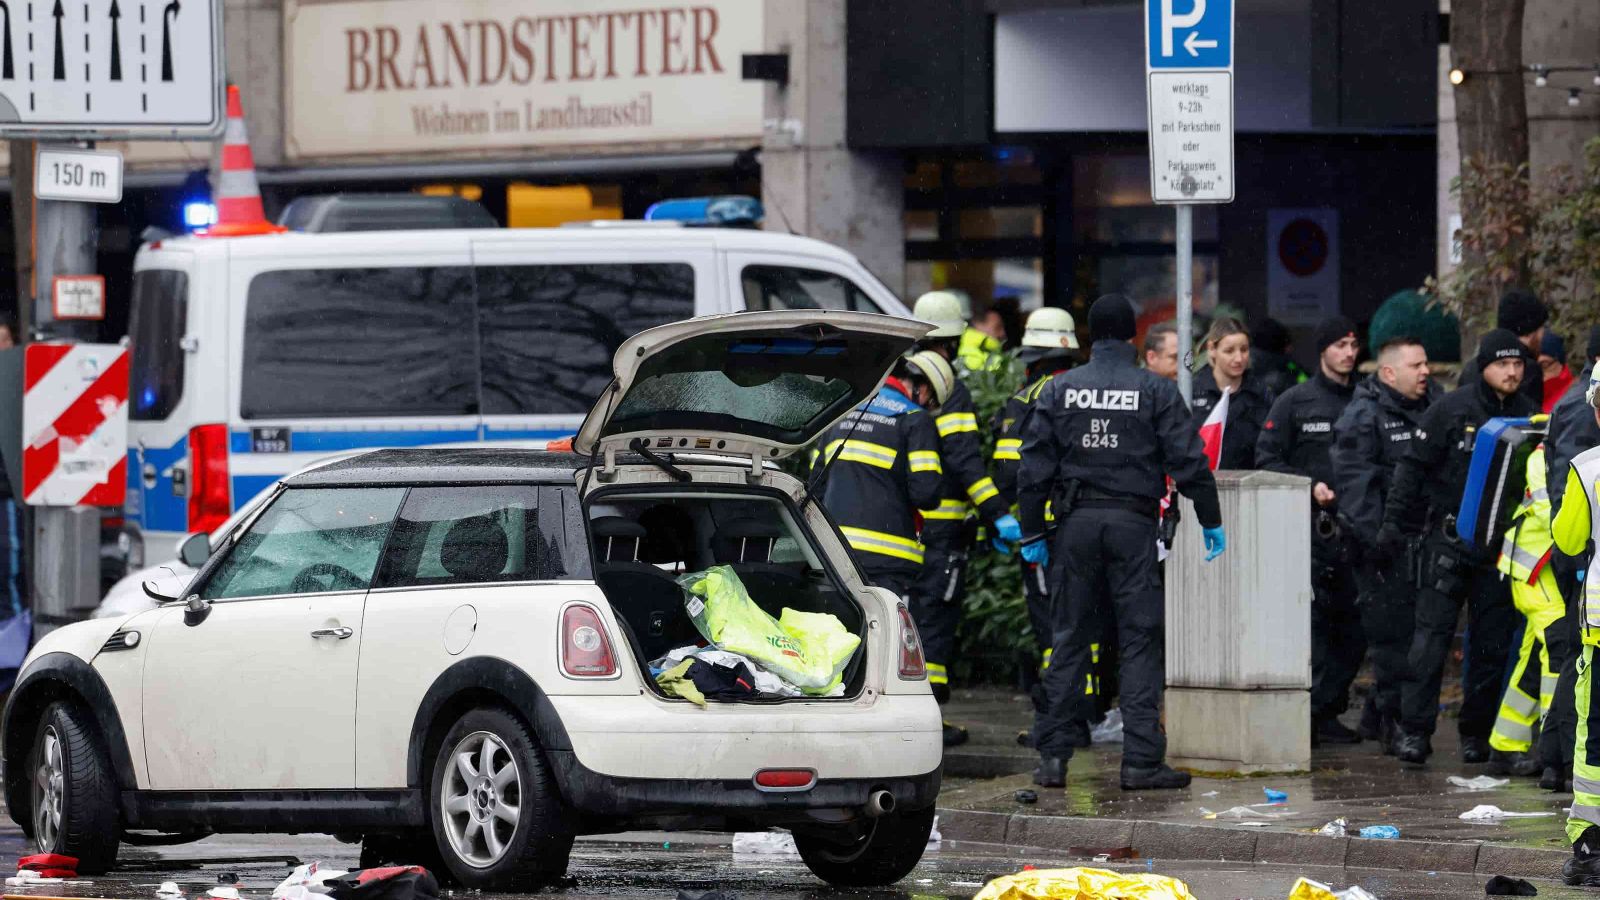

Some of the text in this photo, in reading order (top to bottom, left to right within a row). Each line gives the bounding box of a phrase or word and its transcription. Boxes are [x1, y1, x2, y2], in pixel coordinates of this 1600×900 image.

[1162, 0, 1206, 57] P
[345, 7, 725, 93] BRANDSTETTER
[1172, 82, 1208, 97] werktags
[411, 93, 653, 135] Wohnen im Landhausstil
[1162, 121, 1221, 133] mit Parkschein
[1182, 140, 1200, 152] oder
[1168, 160, 1217, 172] Parkausweis
[53, 162, 106, 188] 150 m
[1170, 179, 1216, 193] Köniplatz
[1064, 388, 1140, 411] POLIZEI
[1091, 419, 1110, 433] BY
[1082, 434, 1119, 448] 6243
